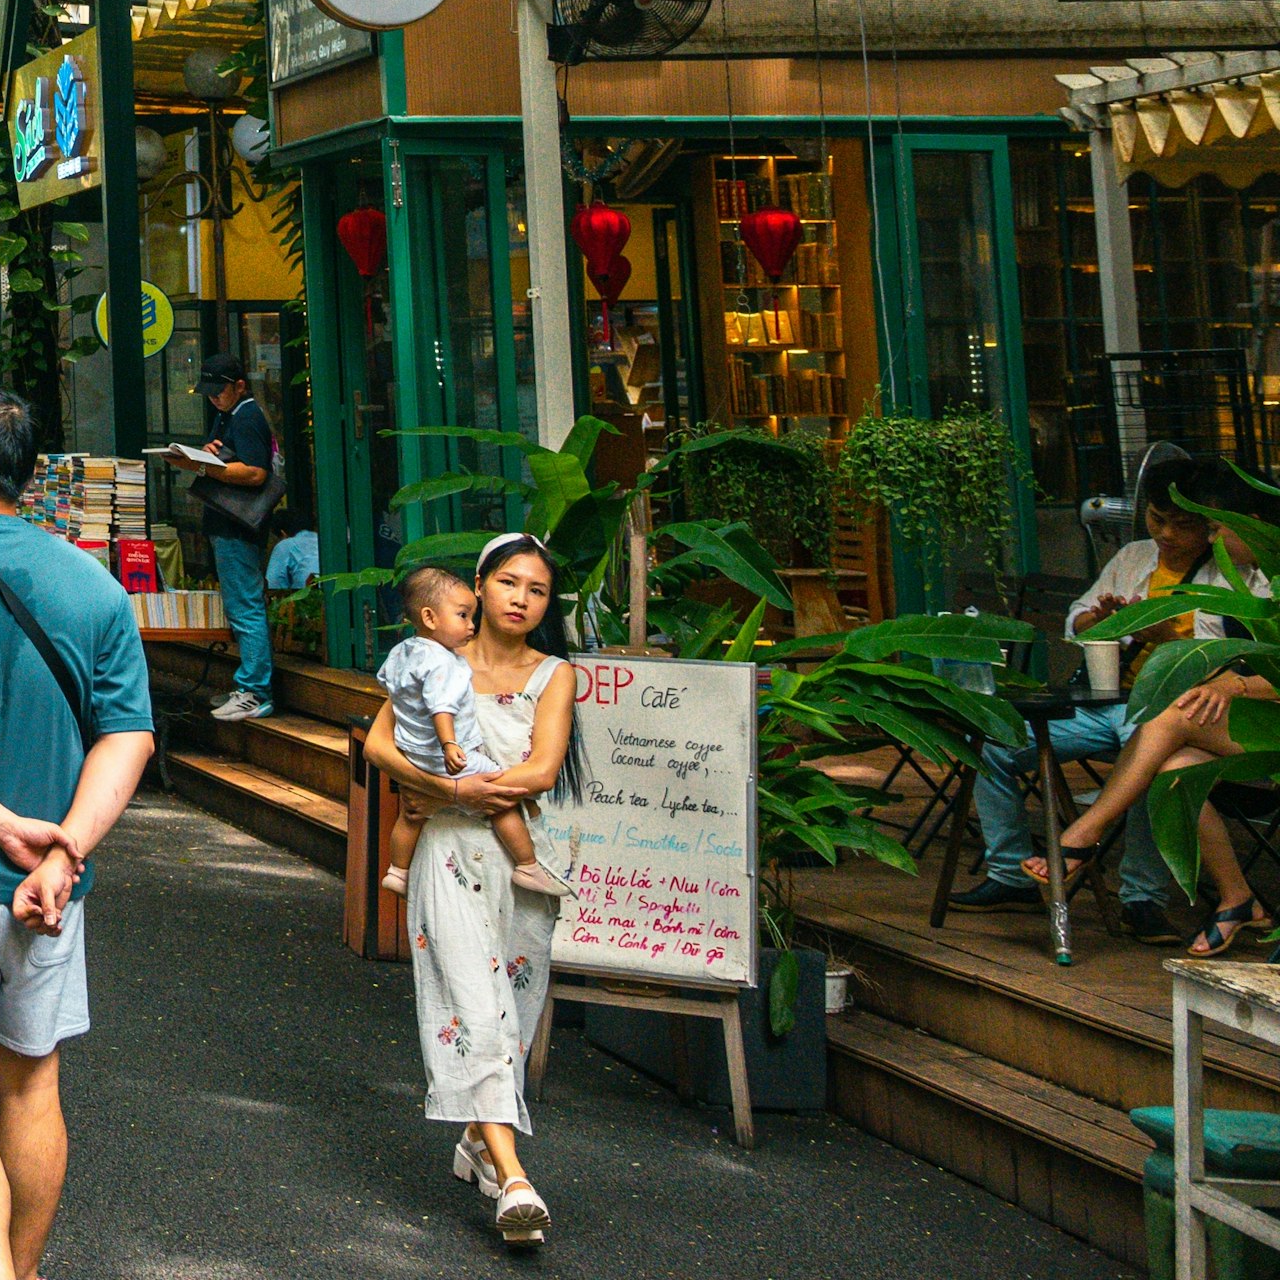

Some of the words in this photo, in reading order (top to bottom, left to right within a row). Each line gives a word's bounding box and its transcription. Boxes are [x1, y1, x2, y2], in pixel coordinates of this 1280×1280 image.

[607, 727, 677, 749] Vietnamese
[611, 747, 656, 768] Coconut
[586, 781, 626, 806] Peach
